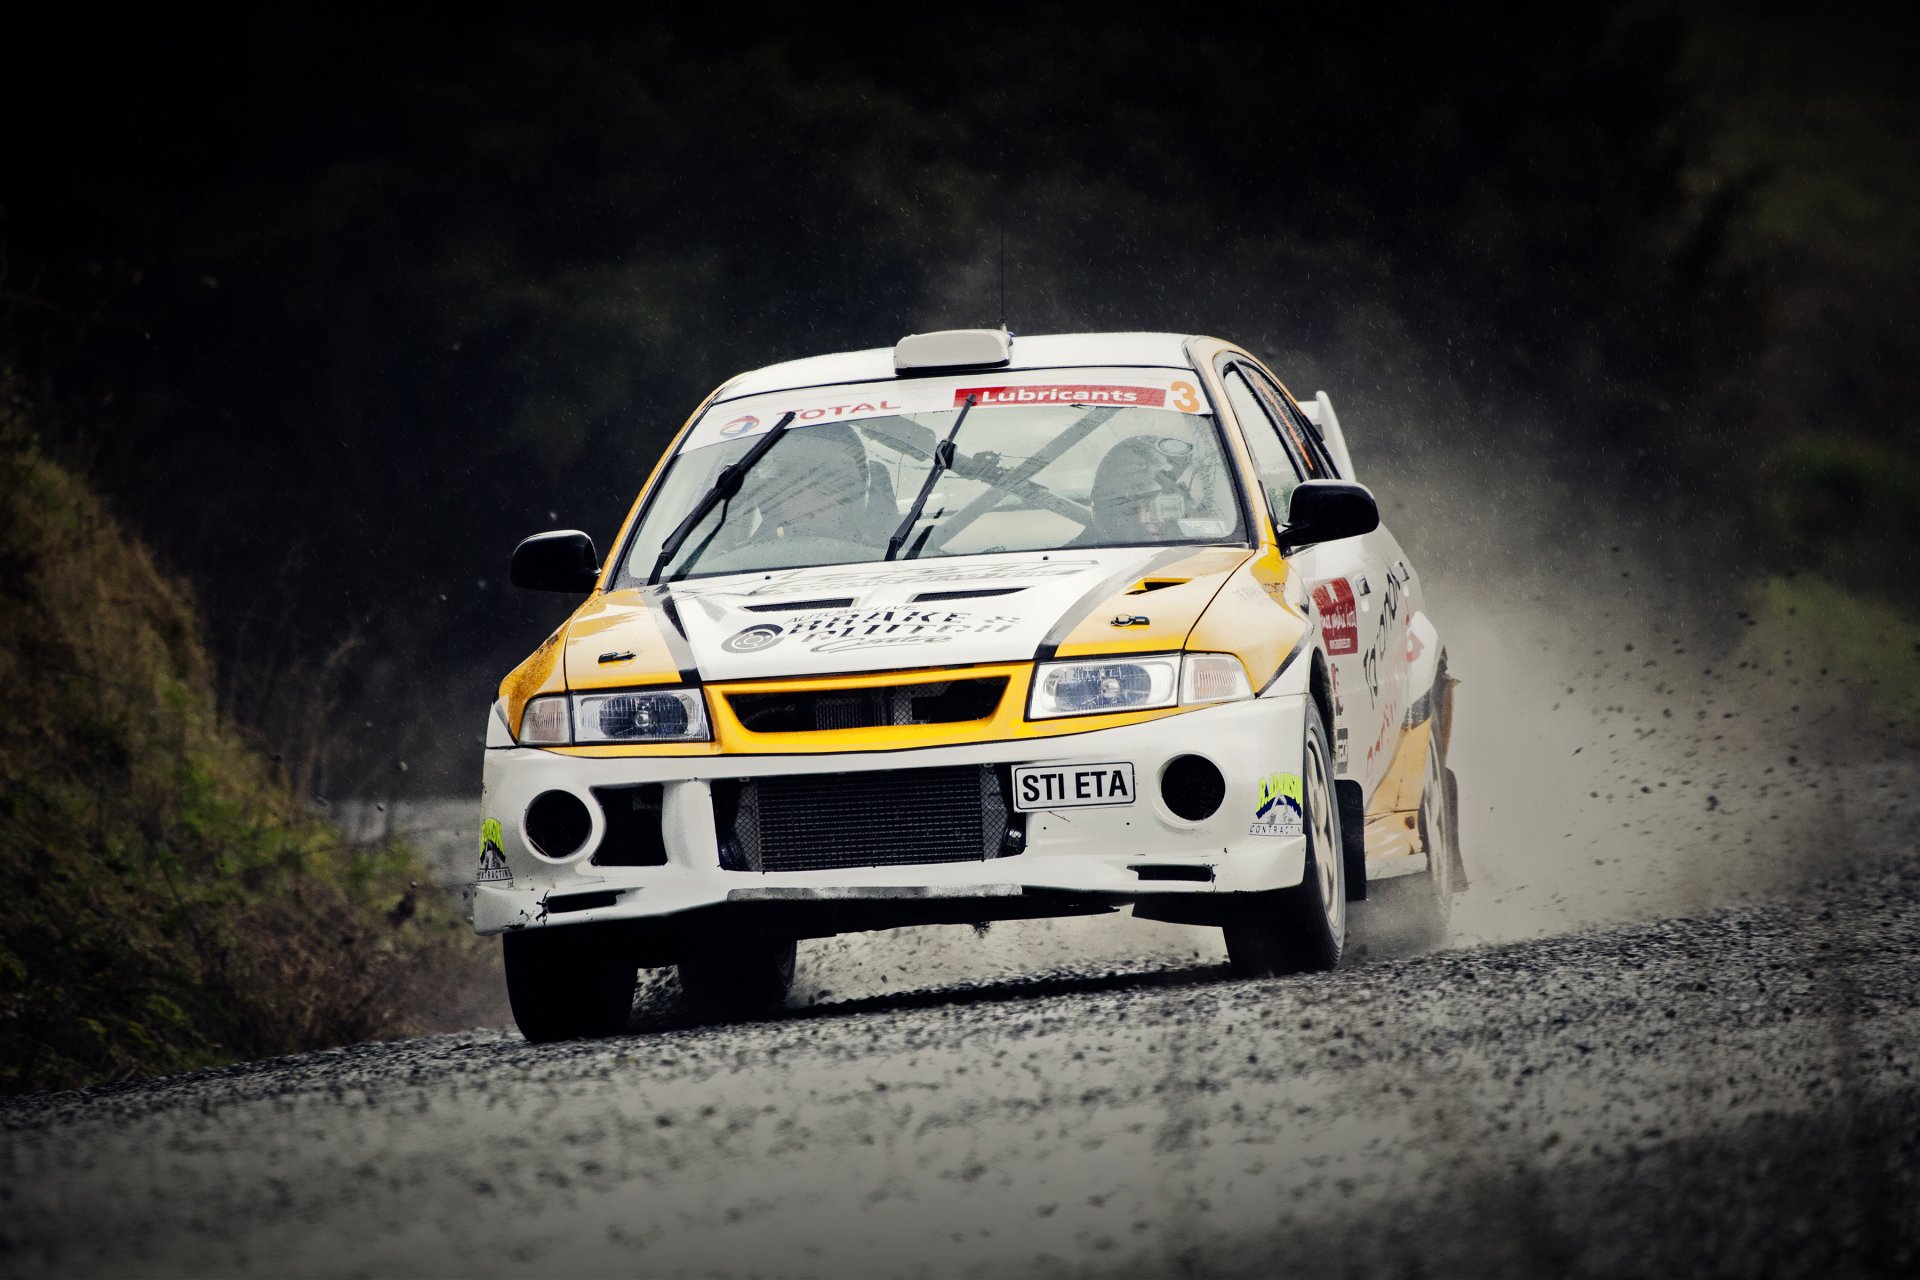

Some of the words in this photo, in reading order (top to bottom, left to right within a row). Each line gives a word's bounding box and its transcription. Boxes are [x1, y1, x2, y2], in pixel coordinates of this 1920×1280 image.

[981, 388, 1138, 403] Lubricants
[1170, 380, 1201, 413] 3
[789, 611, 972, 634] BRAKE
[1022, 774, 1065, 802] STI
[1075, 770, 1128, 799] ETA
